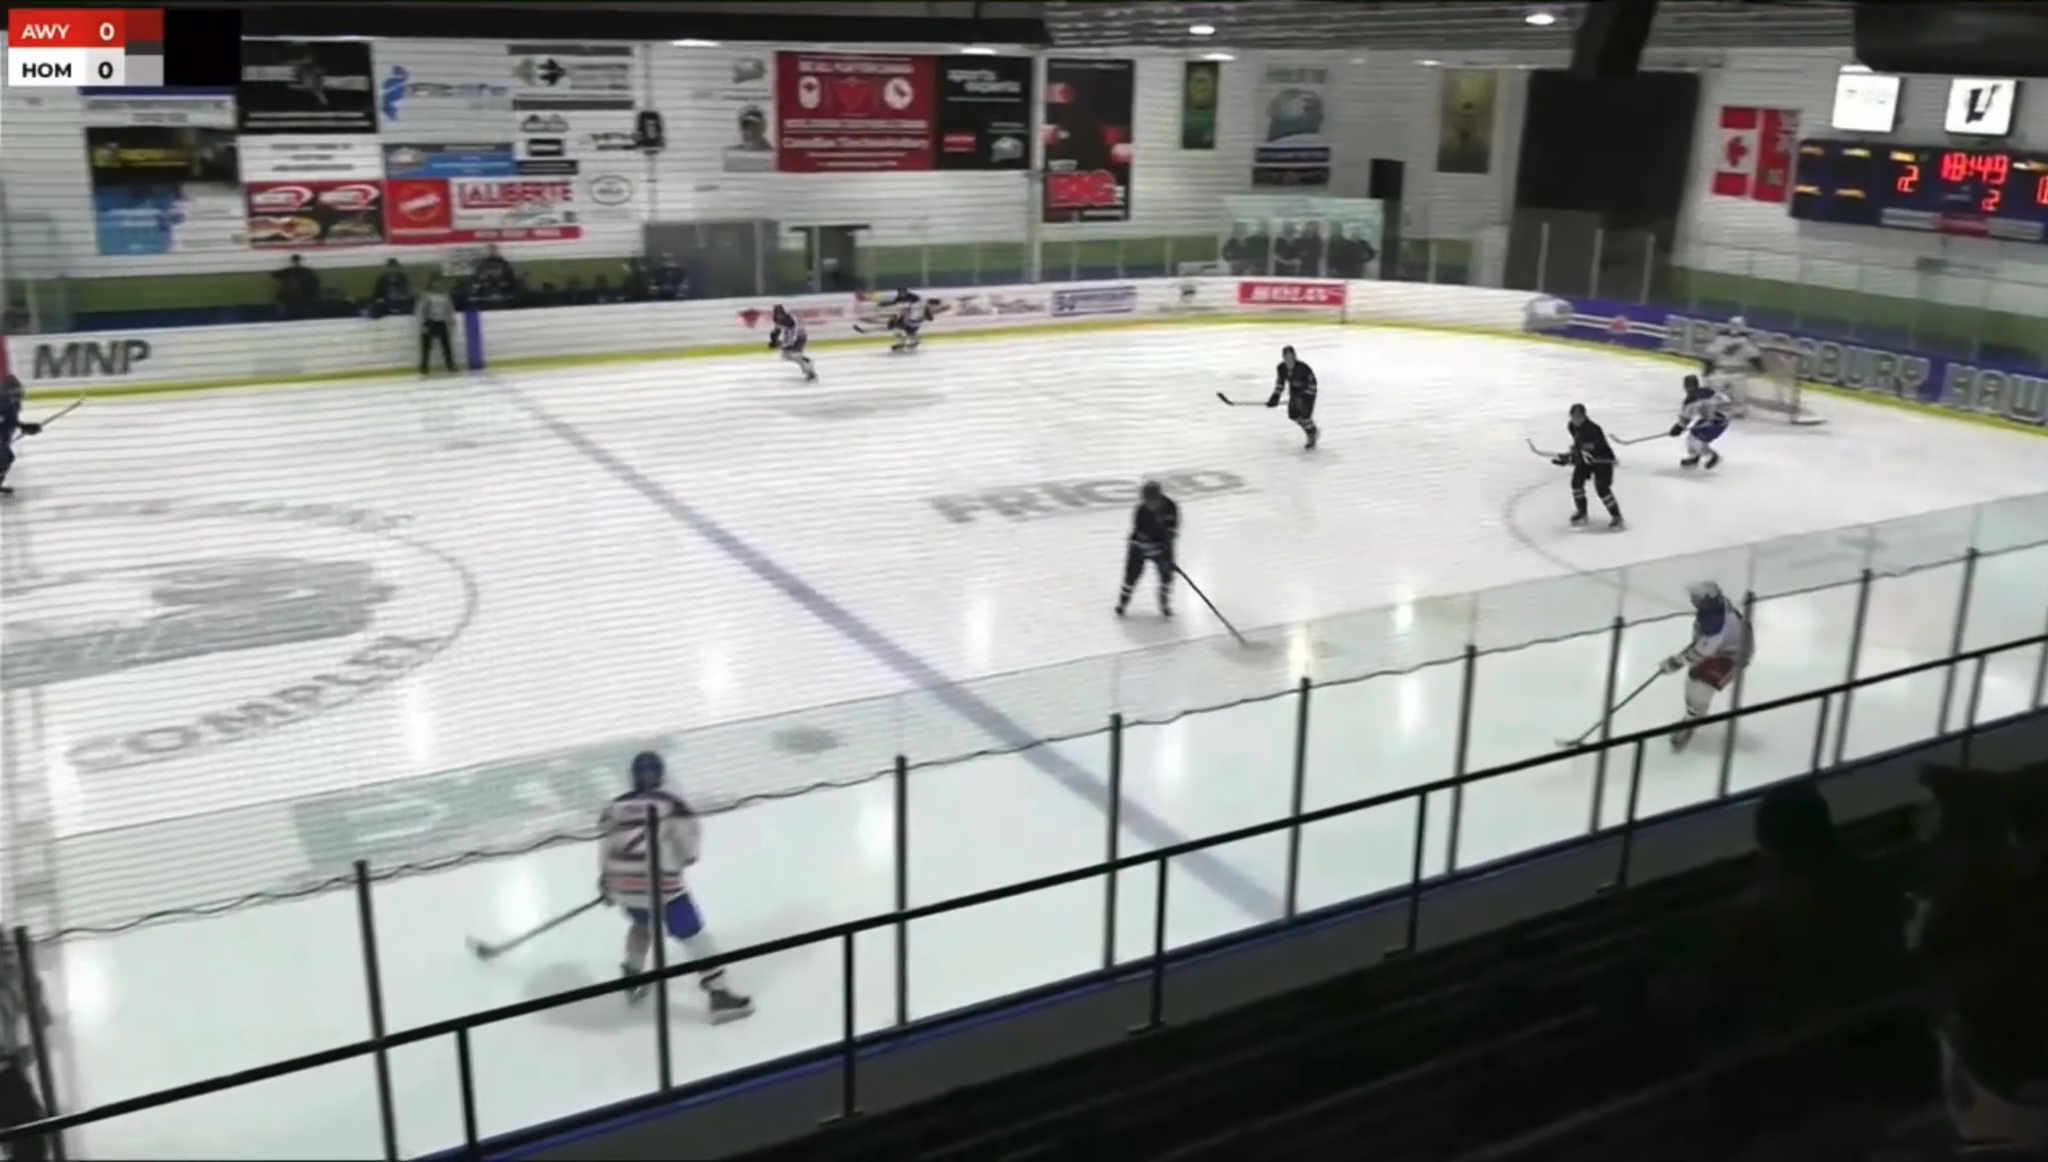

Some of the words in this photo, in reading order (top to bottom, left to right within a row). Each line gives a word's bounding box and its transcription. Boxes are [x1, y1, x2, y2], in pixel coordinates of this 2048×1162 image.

[1897, 165, 1919, 192] 2
[1941, 152, 2007, 184] 18:49
[33, 339, 152, 380] MNP
